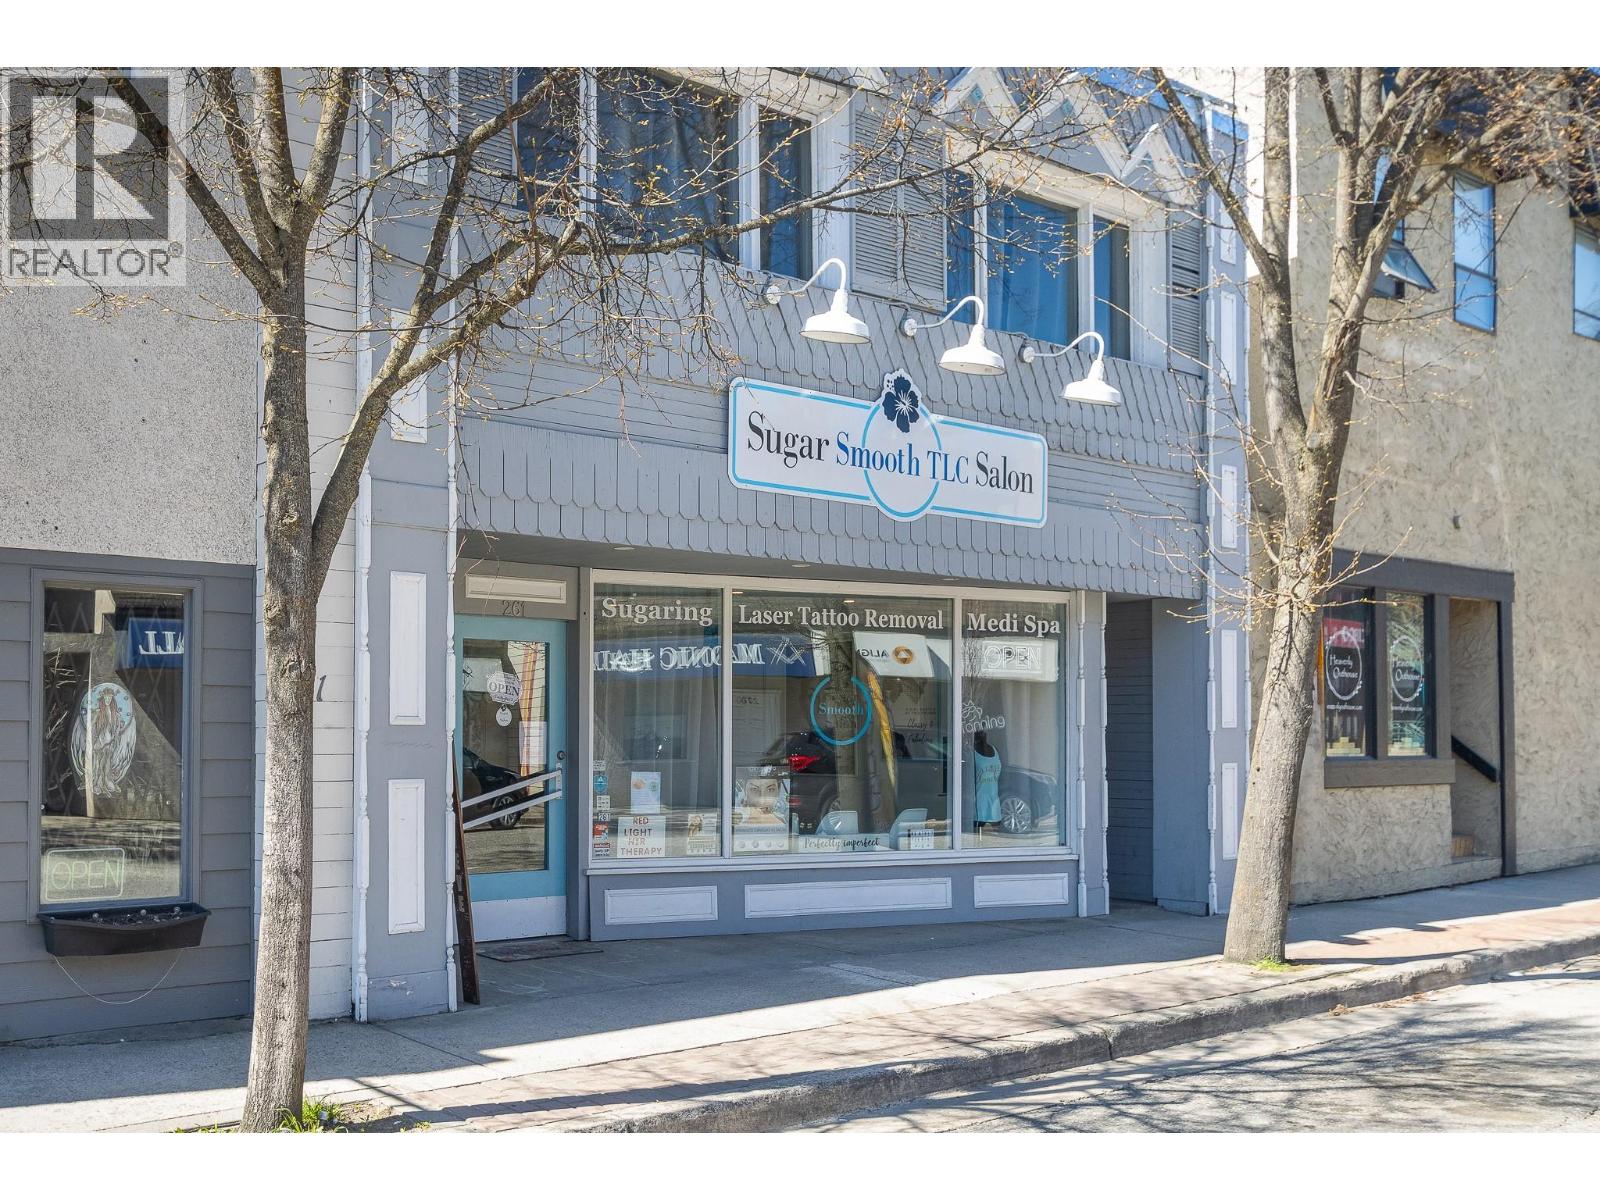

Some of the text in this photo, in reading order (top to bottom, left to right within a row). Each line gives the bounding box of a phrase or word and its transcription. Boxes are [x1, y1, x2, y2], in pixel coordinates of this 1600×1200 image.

[748, 411, 1034, 494] Sugar Smooth TLC Salon
[502, 600, 525, 617] 261
[602, 597, 713, 627] Sugaring
[738, 604, 944, 630] Laser Tattoo Removal
[967, 613, 1061, 637] Medi Spa
[489, 682, 520, 697] OPEN
[624, 828, 652, 837] LIGHT
[620, 847, 662, 856] THERAPY
[51, 860, 120, 890] OPEN
